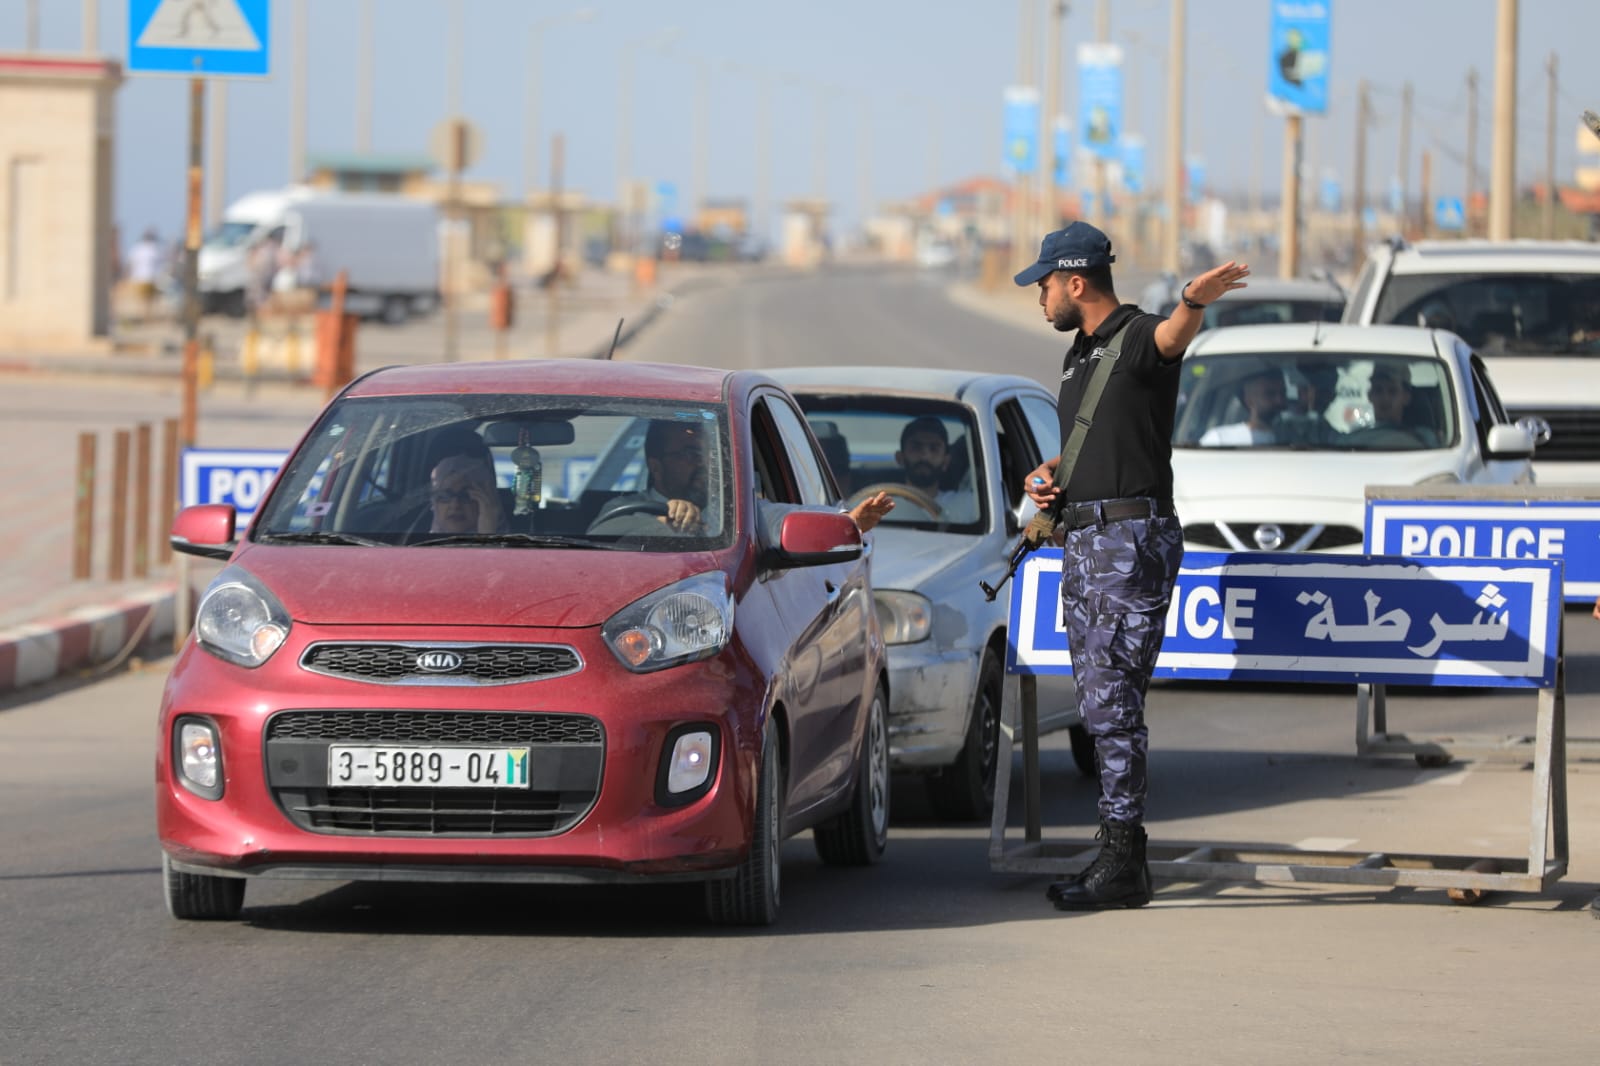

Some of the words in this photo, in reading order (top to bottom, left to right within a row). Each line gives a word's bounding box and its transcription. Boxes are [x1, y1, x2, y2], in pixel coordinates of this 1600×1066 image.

[1058, 258, 1088, 268] POLICE
[1401, 524, 1565, 559] POLICE
[1296, 583, 1510, 658] شرطة
[424, 655, 454, 667] KIA
[339, 751, 499, 783] 3-5889-04
